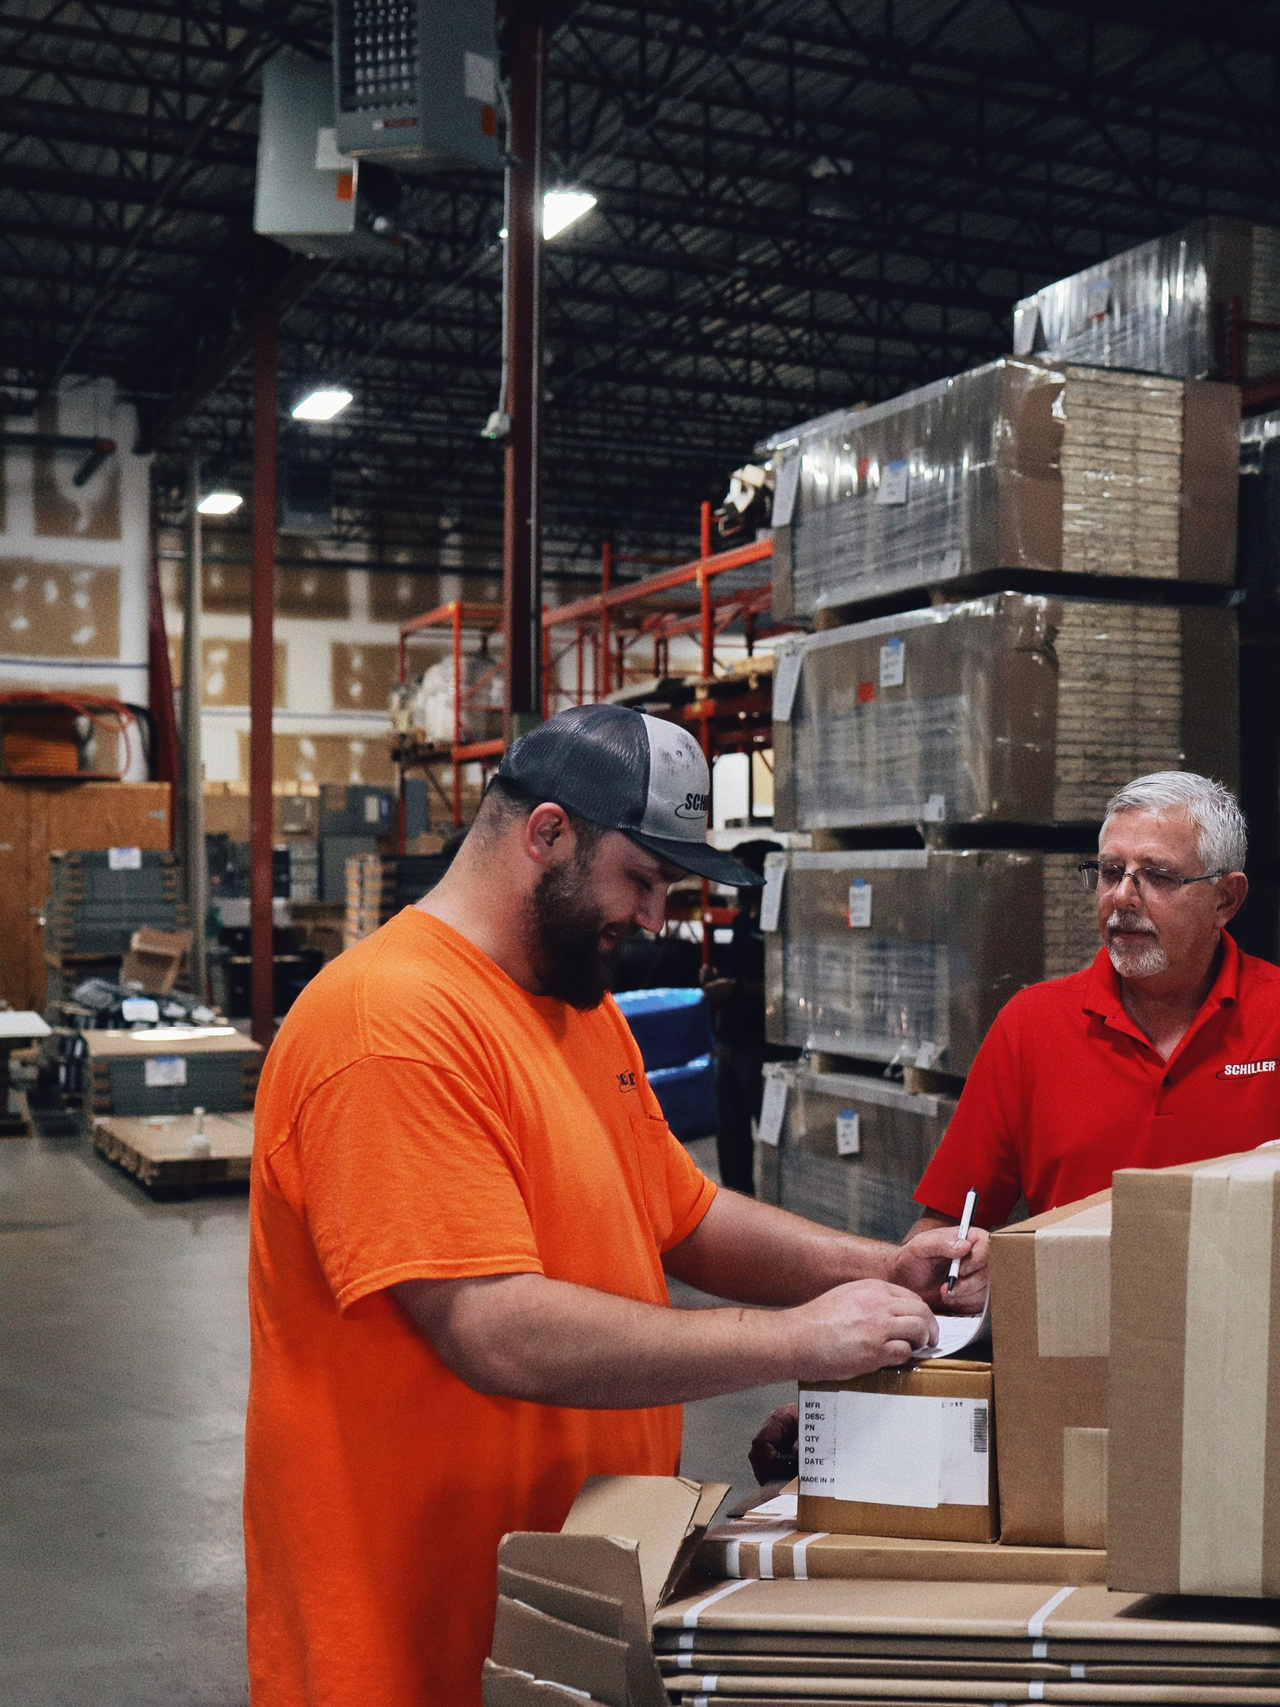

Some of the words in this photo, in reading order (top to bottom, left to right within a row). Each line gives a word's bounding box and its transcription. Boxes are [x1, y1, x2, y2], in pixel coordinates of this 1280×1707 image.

[1223, 1060, 1276, 1076] SCHILLER
[804, 1401, 821, 1409] MFR
[804, 1413, 825, 1421] DESC
[804, 1424, 815, 1432] PN
[804, 1435, 820, 1443] QTY
[804, 1446, 815, 1454] PO
[804, 1458, 825, 1466] DATE
[800, 1475, 819, 1483] MADE
